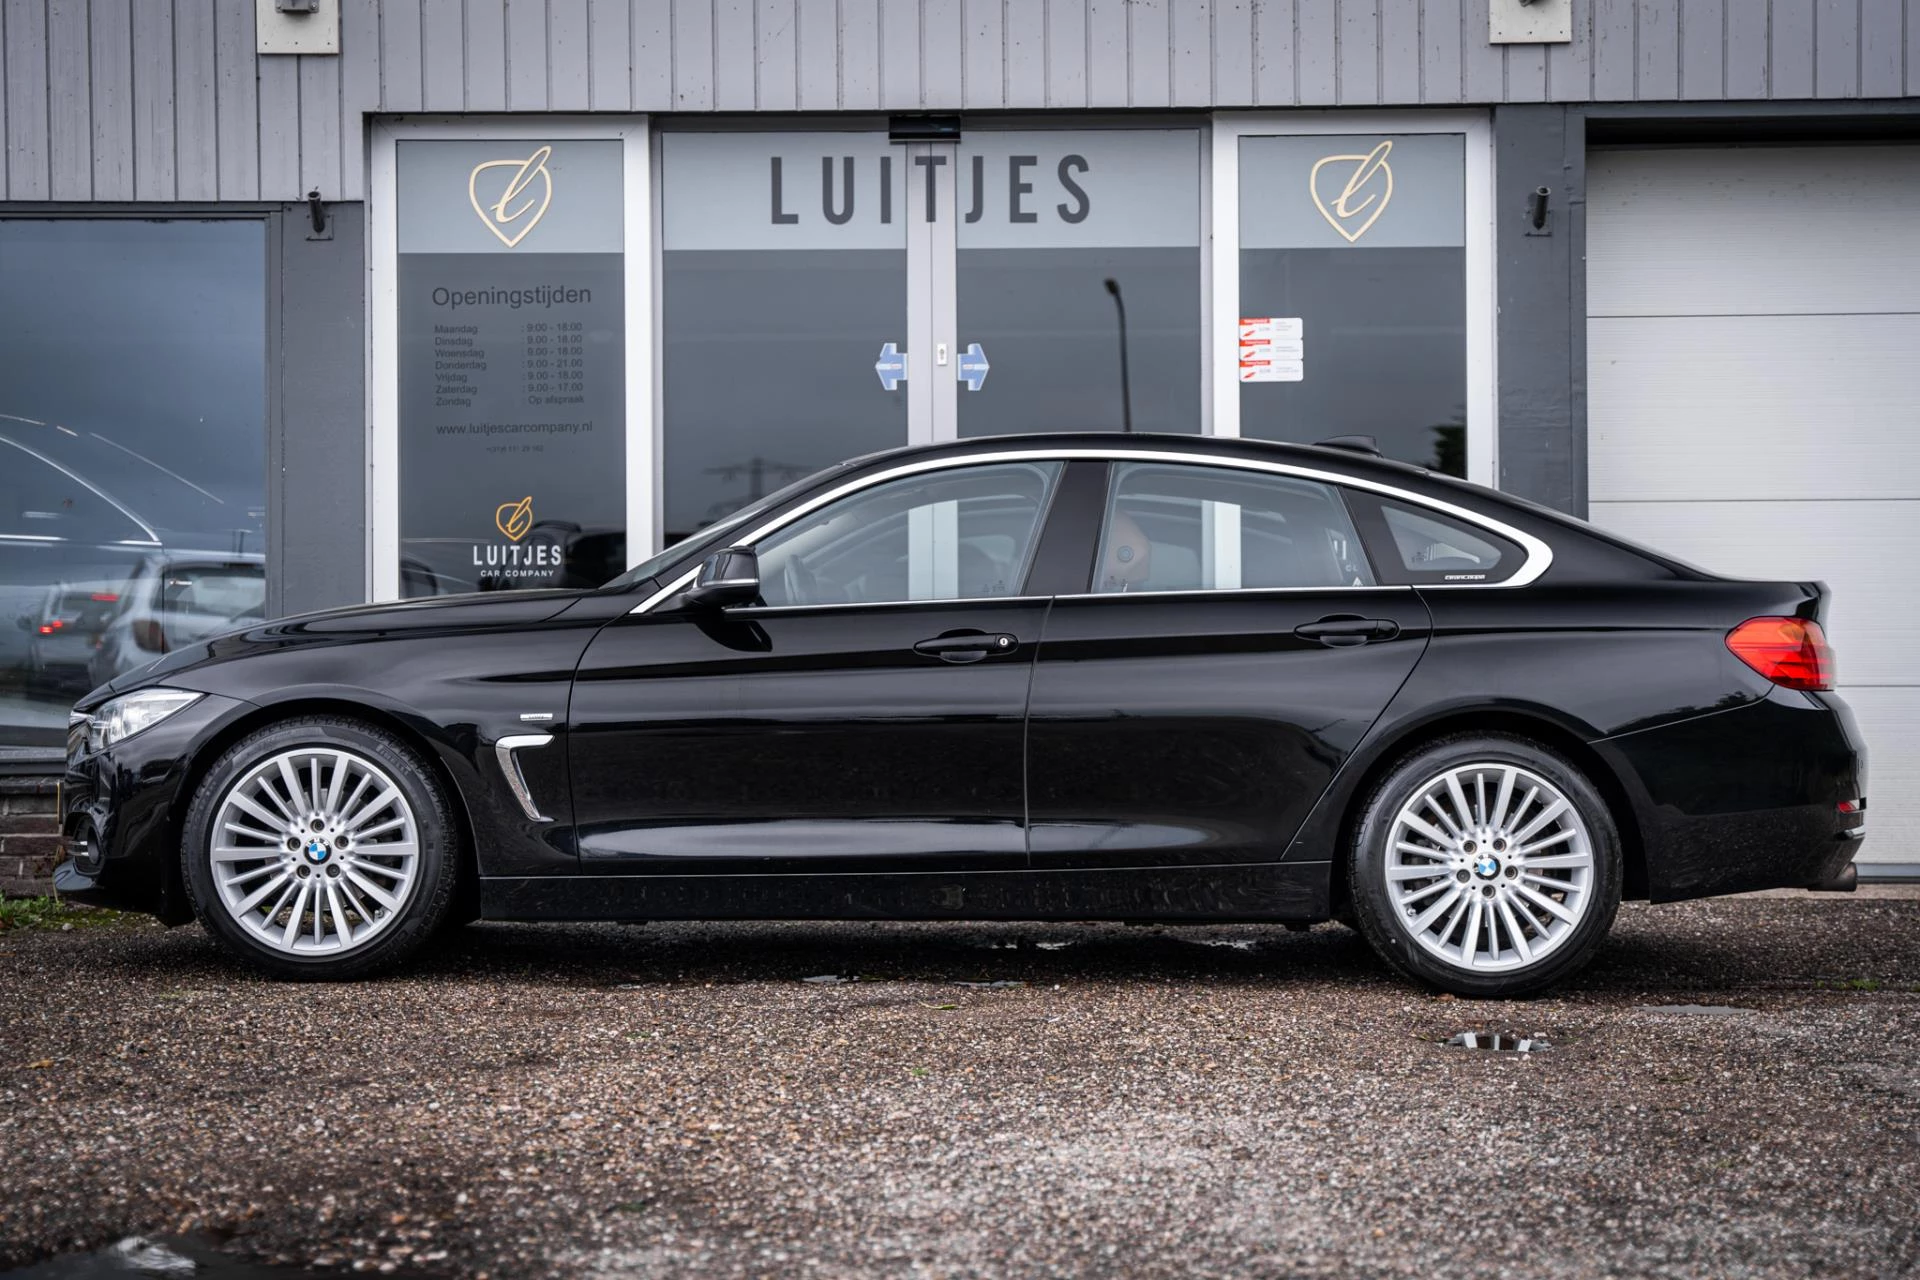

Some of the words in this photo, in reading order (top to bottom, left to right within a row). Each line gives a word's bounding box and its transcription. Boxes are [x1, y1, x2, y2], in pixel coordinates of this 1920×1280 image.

[771, 154, 1090, 225] LUITJES
[432, 285, 592, 310] Openingstijden
[435, 324, 478, 335] Maandag
[435, 336, 473, 347] Dinsdag
[527, 335, 548, 344] 9.00
[557, 334, 582, 344] 18.00
[435, 349, 485, 359] Woensdag
[527, 347, 548, 356] 9.00
[557, 346, 582, 356] 18.00
[435, 360, 487, 371] Donderdag
[527, 359, 548, 368] 9.00
[556, 358, 583, 368] 21.00
[435, 373, 468, 383] Vrijdag
[528, 371, 548, 380] 9.00
[558, 370, 584, 380] 18.00
[435, 385, 478, 395] Zaterdag
[528, 383, 548, 392] 9.00
[558, 382, 584, 392] 17.00
[435, 396, 471, 407] Zondag
[528, 396, 542, 405] Op
[545, 395, 584, 405] afspraak
[436, 421, 593, 436] www.luitjescarcompany.nl
[473, 545, 562, 565] LUITJES
